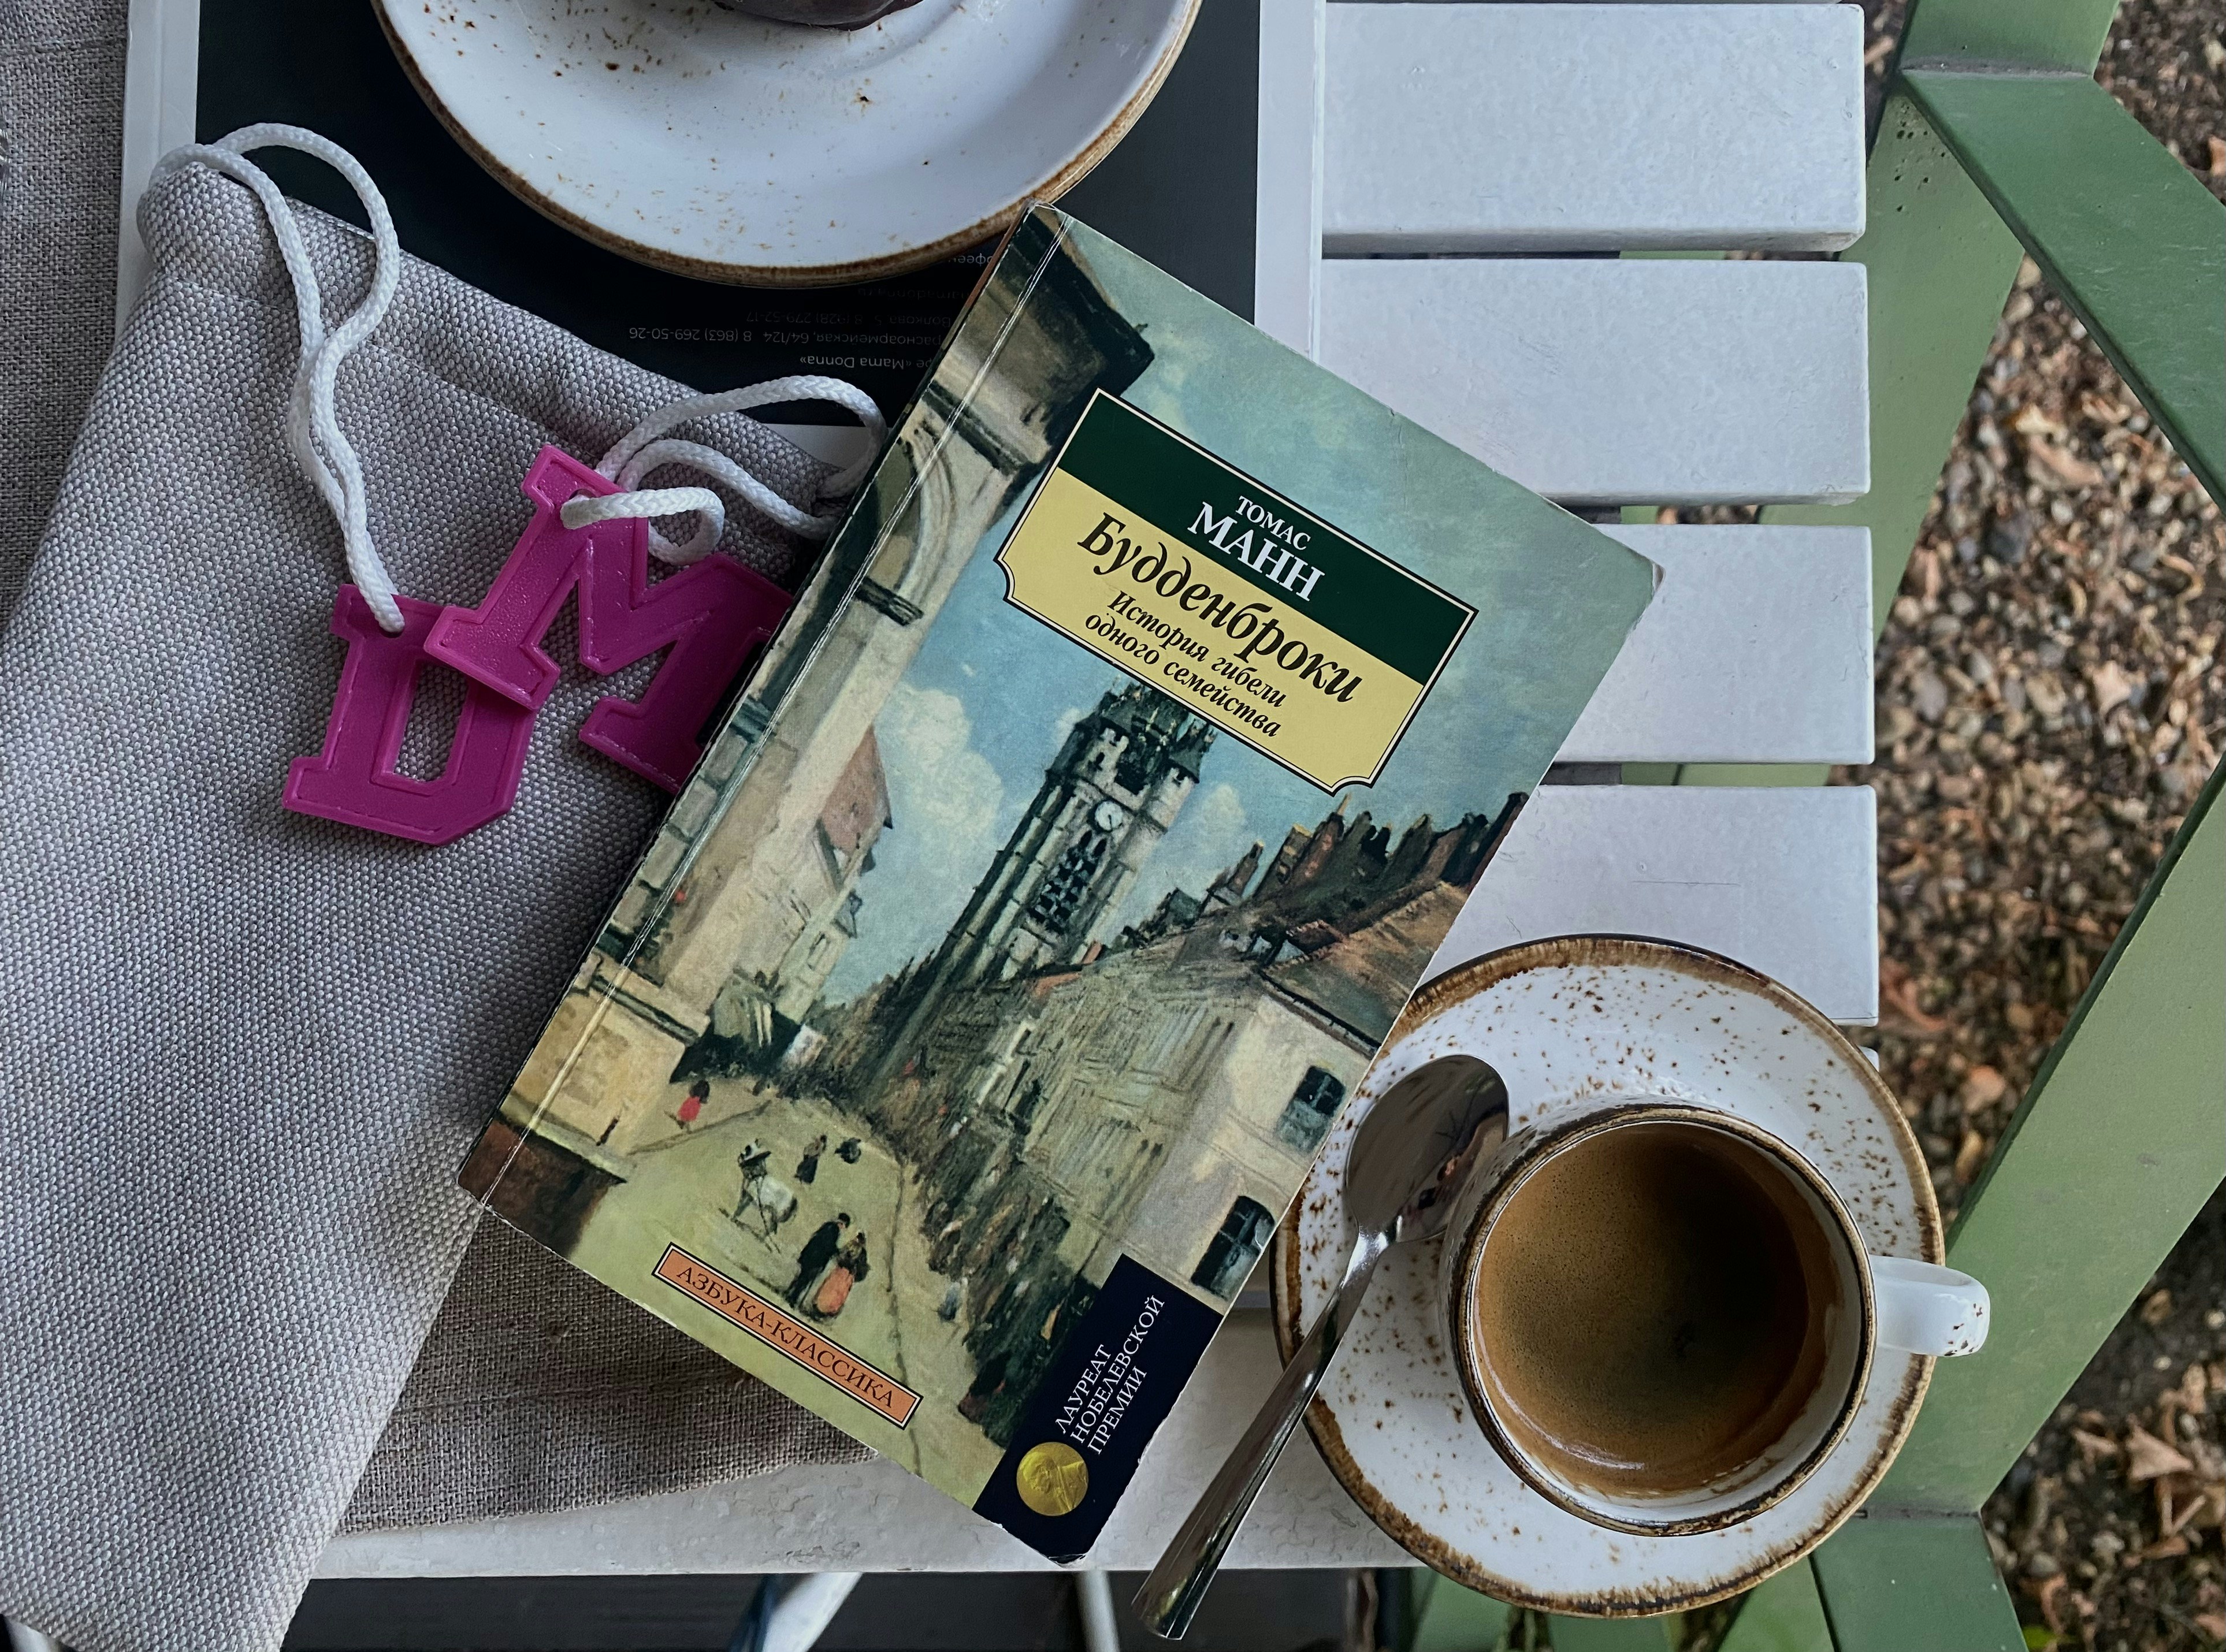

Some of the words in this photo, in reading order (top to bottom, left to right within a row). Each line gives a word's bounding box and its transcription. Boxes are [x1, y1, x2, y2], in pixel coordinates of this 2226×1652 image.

[629, 327, 701, 340] 269-50-26
[704, 328, 738, 342] (863)
[743, 330, 752, 341] 8
[746, 310, 812, 323] 279-52-17
[763, 330, 809, 345] 64/124
[813, 330, 942, 347] расноармейская,
[800, 355, 855, 369] Donna»
[860, 356, 912, 370] «Mama
[1187, 501, 1325, 602] МАНН
[1235, 495, 1311, 552] ТОМАС
[1077, 512, 1362, 703] Будденброки
[1085, 615, 1160, 665] одного
[1163, 663, 1282, 738] семейства
[1107, 590, 1209, 662] История
[1211, 655, 1287, 708] гибели
[676, 1265, 894, 1409] АЗБУКА-КЛАССИКА
[1055, 1344, 1112, 1434] ЛАУРЕАТ
[1070, 1295, 1165, 1443] НОБЕЛЕВСКОЙ
[1087, 1365, 1147, 1454] ПРЕМИИ
